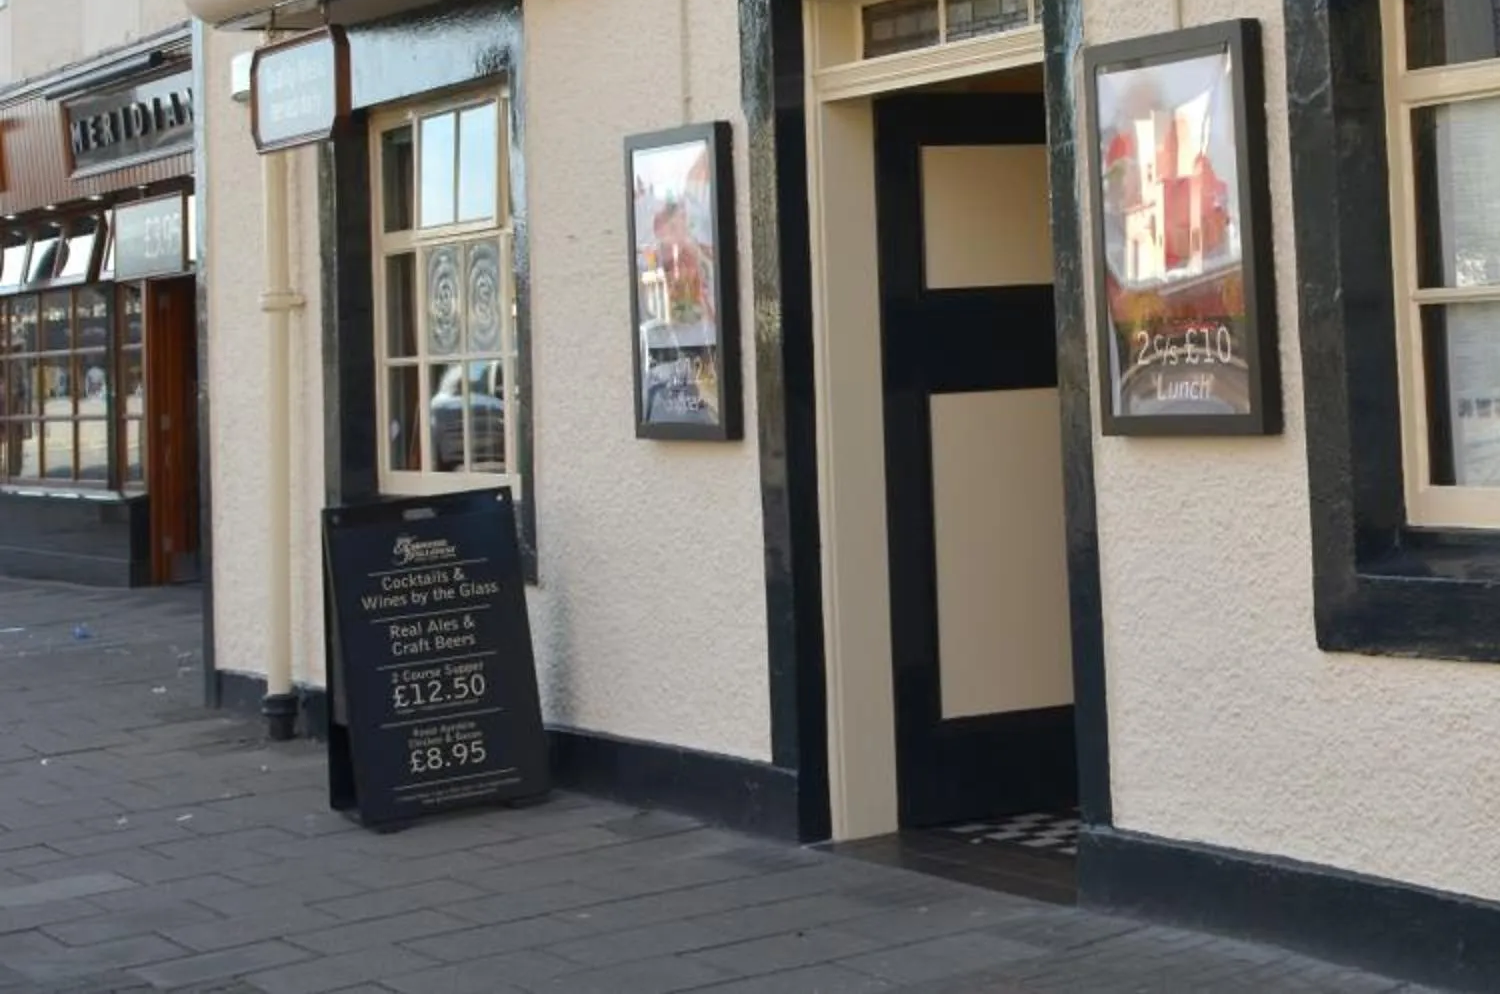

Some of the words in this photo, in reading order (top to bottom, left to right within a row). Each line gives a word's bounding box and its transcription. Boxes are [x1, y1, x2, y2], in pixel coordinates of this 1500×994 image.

[1137, 329, 1152, 366] 2
[1184, 325, 1232, 365] £10
[361, 590, 408, 611] Wines
[411, 587, 429, 606] by
[432, 584, 457, 601] the
[459, 578, 500, 598] Glass
[381, 569, 450, 591] Cocktails
[453, 567, 466, 582] &
[389, 621, 423, 641] Real
[427, 616, 459, 635] Ales
[463, 613, 476, 629] &
[392, 636, 431, 657] Craft
[435, 631, 476, 651] Beers
[392, 673, 486, 708] £12.50
[409, 740, 487, 774] £8.95
